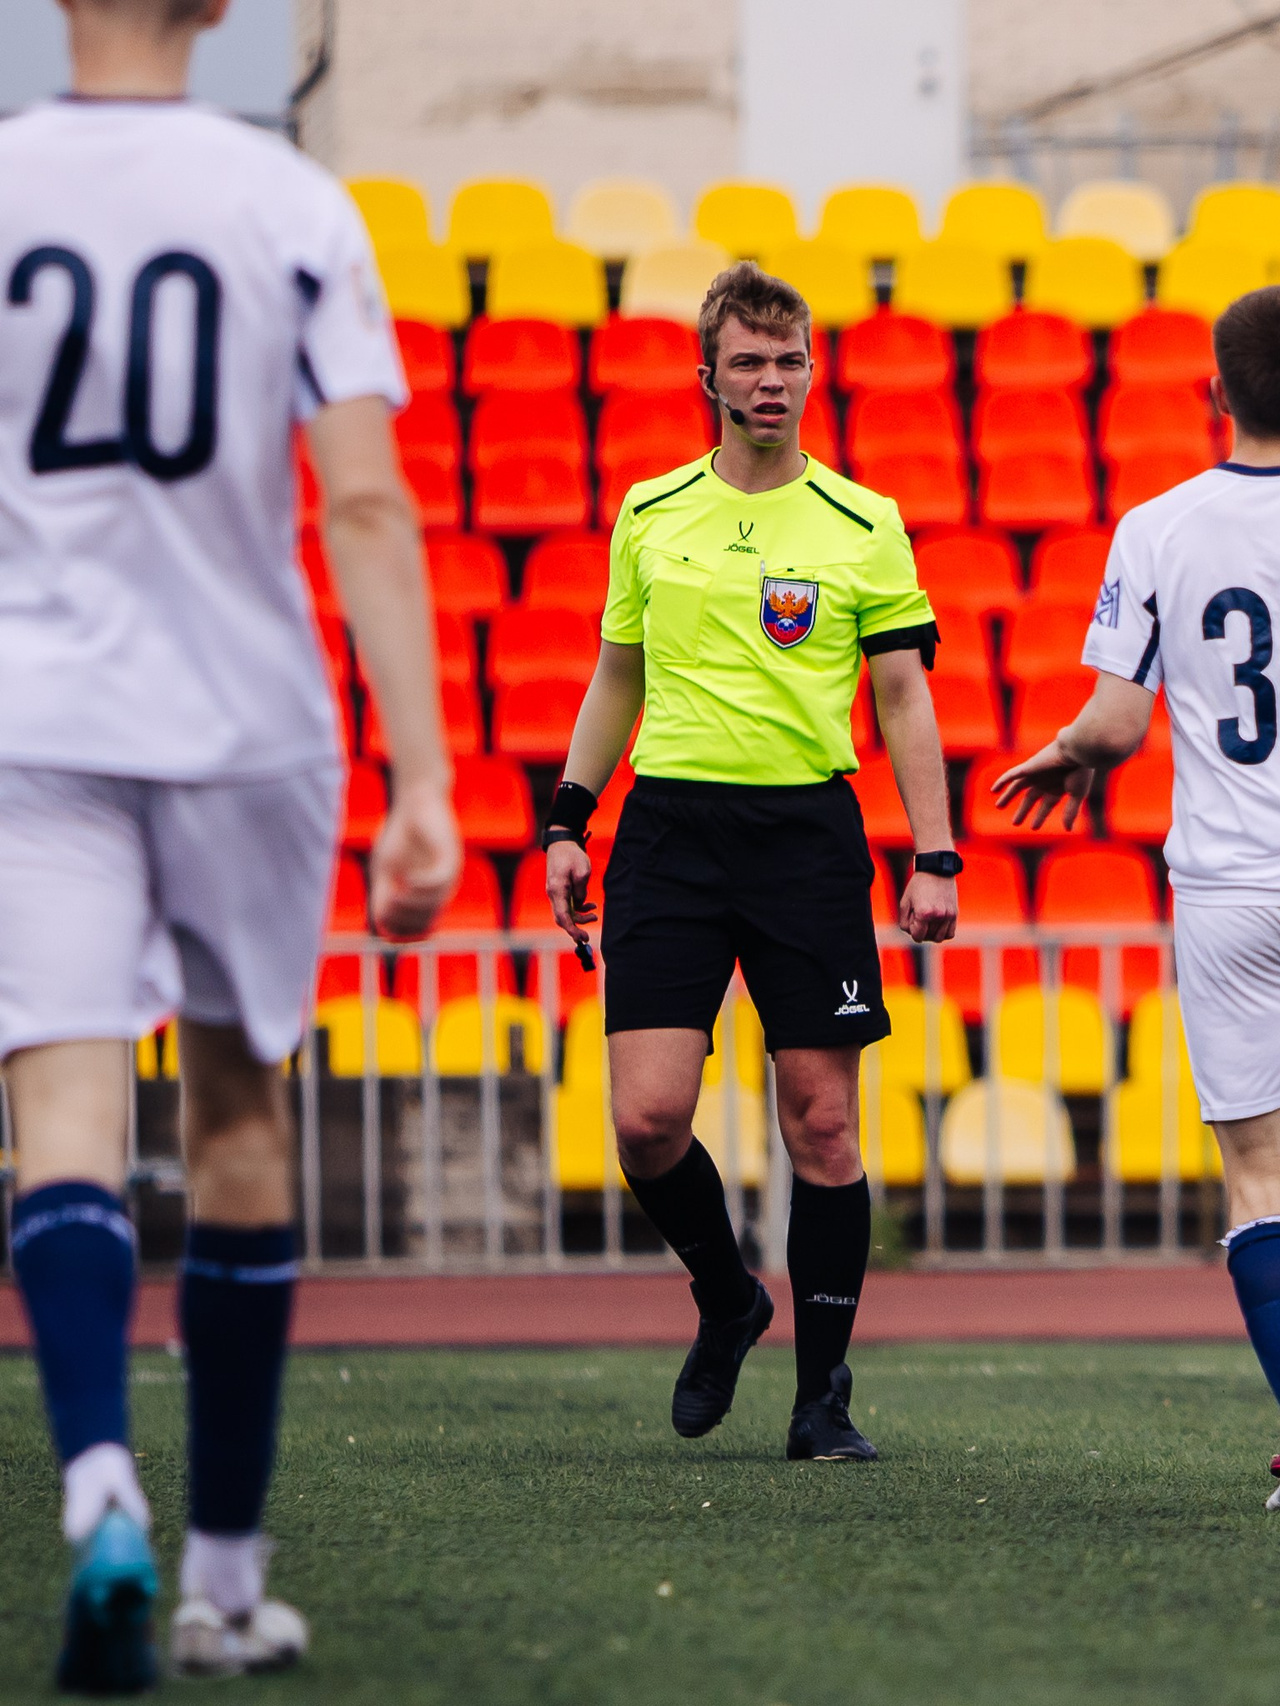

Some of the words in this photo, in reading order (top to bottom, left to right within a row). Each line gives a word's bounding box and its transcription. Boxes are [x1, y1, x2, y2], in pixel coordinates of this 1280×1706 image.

[8, 246, 222, 481] 20
[723, 543, 760, 555] JÖGEL
[834, 1004, 870, 1015] JÖGEL
